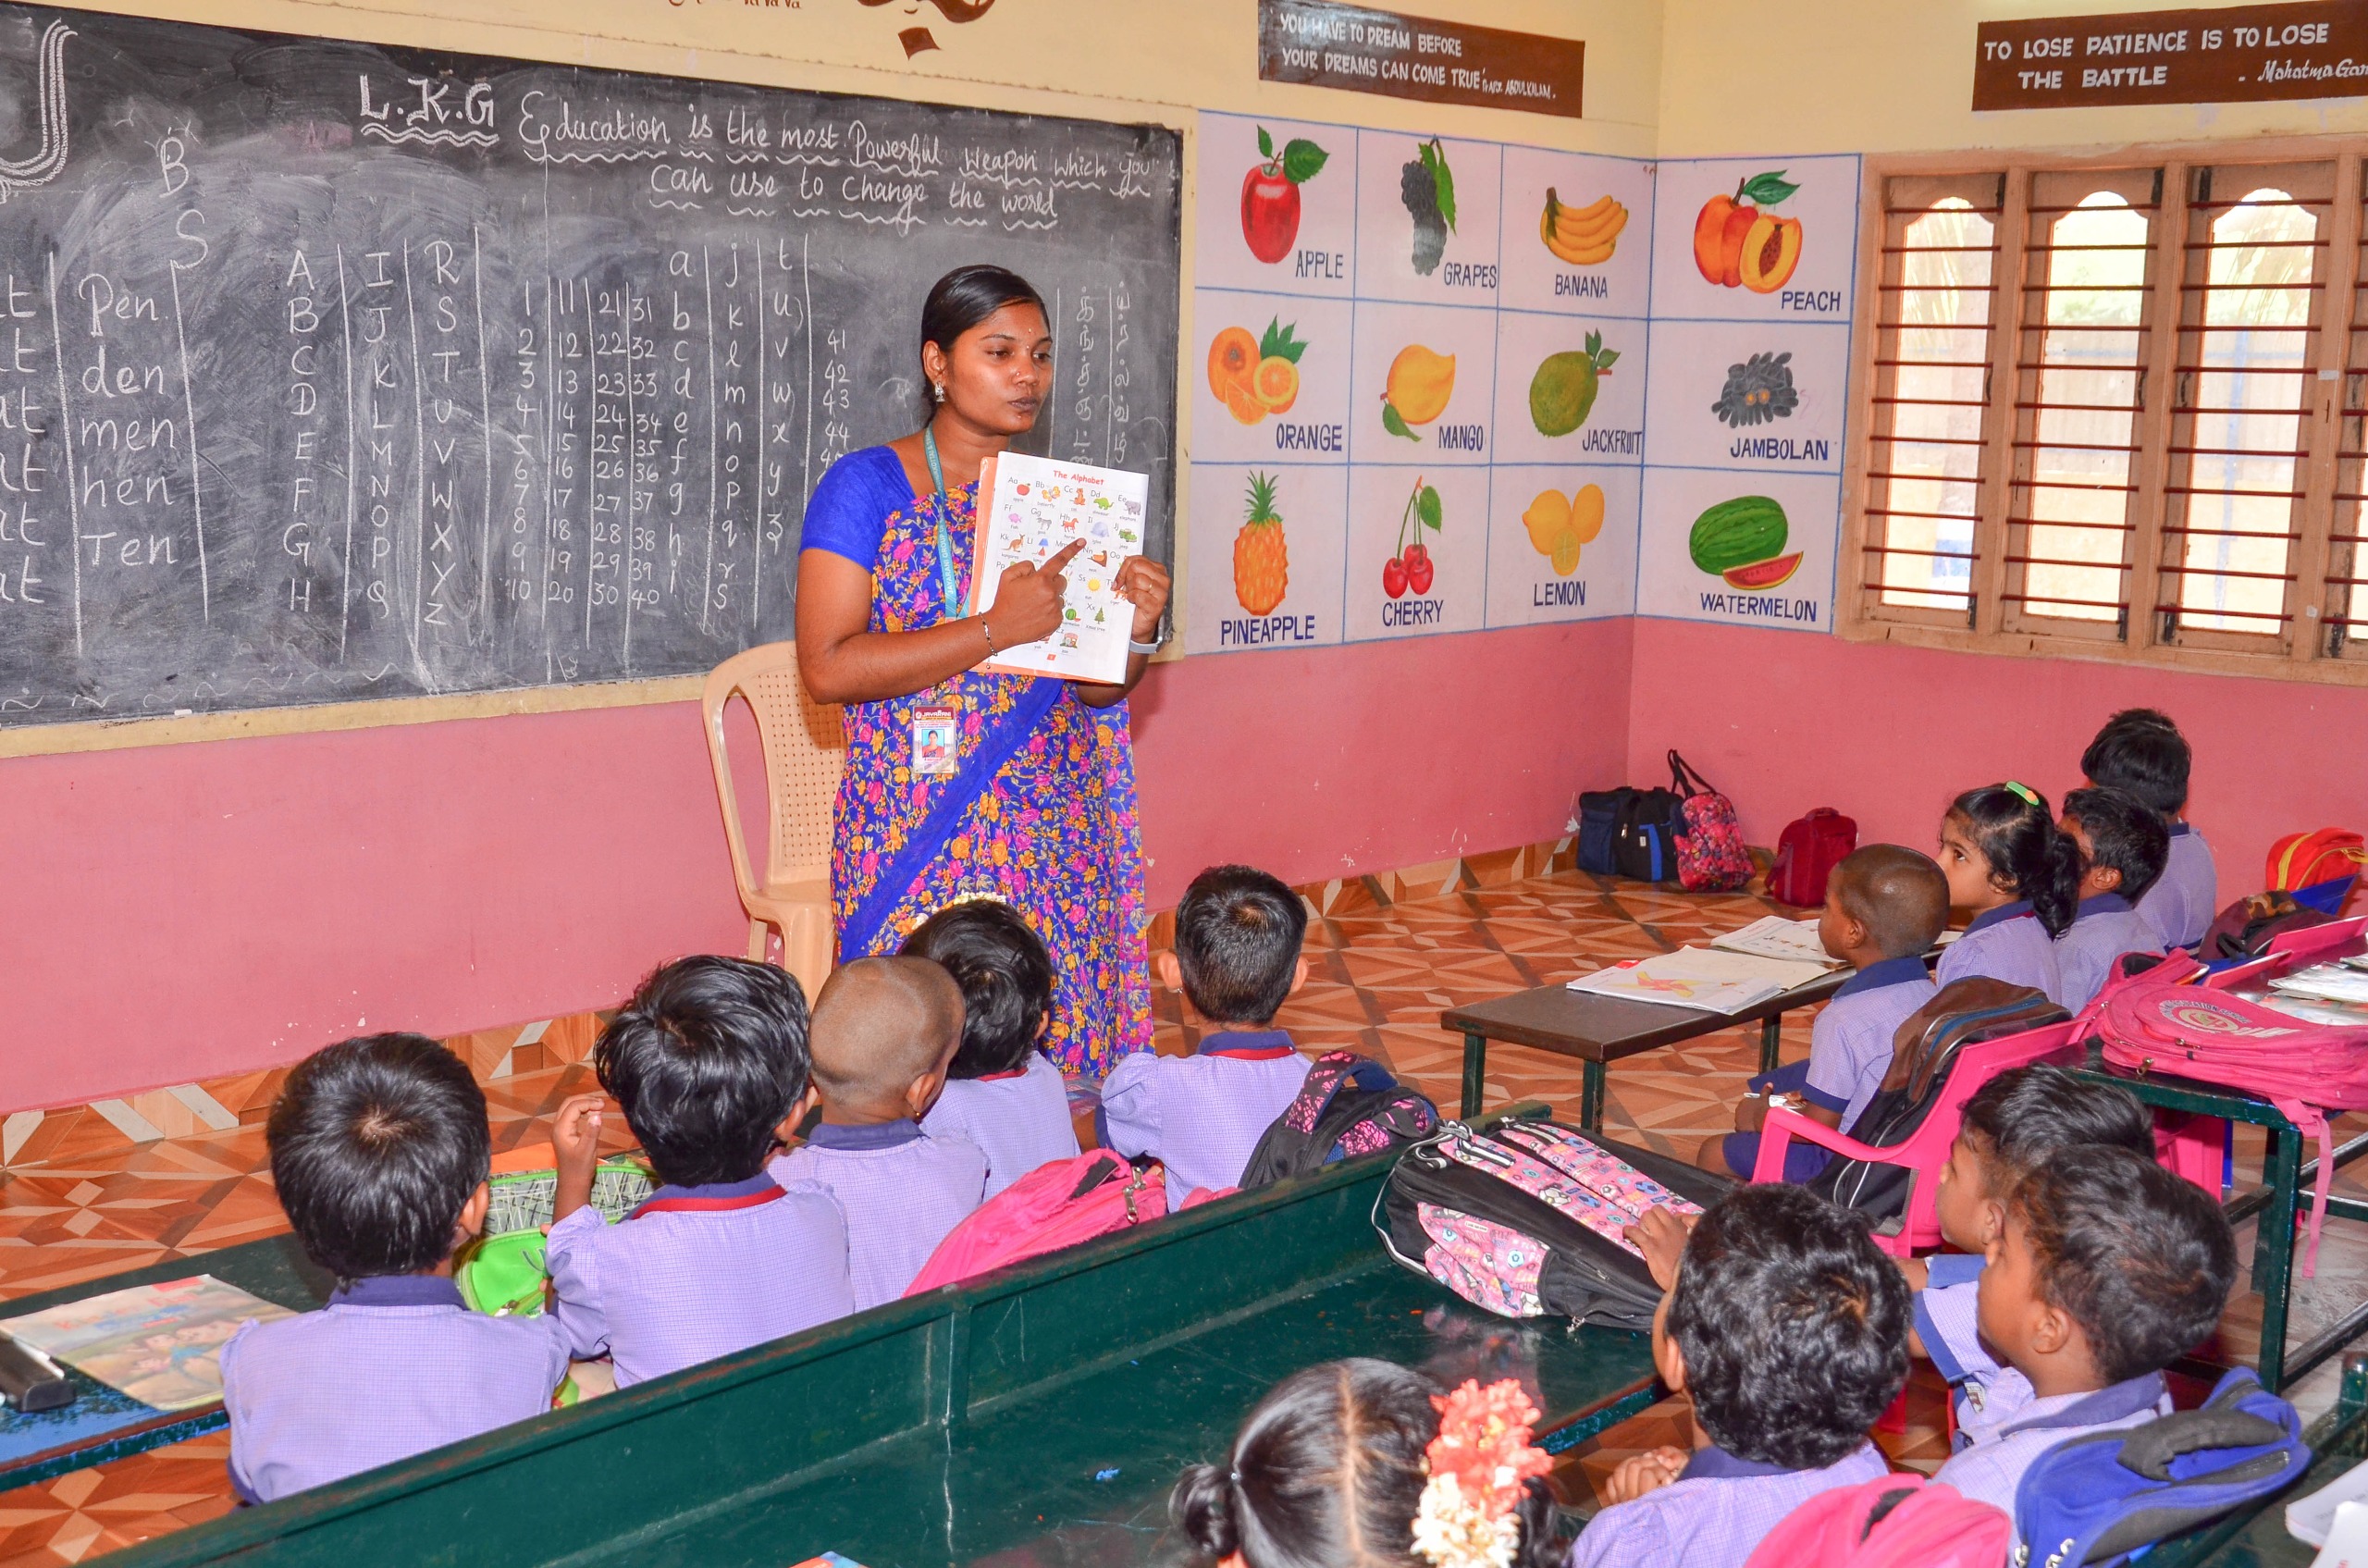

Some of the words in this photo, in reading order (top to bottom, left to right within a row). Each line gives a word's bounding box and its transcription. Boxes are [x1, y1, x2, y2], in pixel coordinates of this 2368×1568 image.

[1312, 18, 1346, 41] HAVE
[1350, 23, 1363, 43] TO
[1368, 26, 1410, 50] DREAM
[1418, 33, 1462, 57] BEFORE
[1985, 41, 2012, 61] TO
[2023, 37, 2074, 60] LOSE
[2086, 30, 2188, 56] PATIENCE
[2202, 29, 2223, 50] IS
[2233, 27, 2260, 48] TO
[2265, 23, 2329, 46] LOSE
[1282, 47, 1318, 70] YOUR
[1325, 52, 1377, 78] DREAMS
[1382, 60, 1408, 80] CAN
[1412, 63, 1446, 85] COME
[2018, 70, 2063, 89] THE
[2082, 66, 2167, 88] BATTLE
[2257, 58, 2332, 83] Mahatma
[688, 104, 713, 140] is
[727, 105, 771, 146] the
[1054, 154, 1107, 178] which
[731, 174, 777, 197] use
[800, 167, 823, 200] to
[950, 181, 985, 208] the
[1003, 187, 1057, 217] world
[425, 241, 460, 284] R
[670, 250, 692, 278] a
[725, 243, 739, 288] j
[780, 239, 793, 270] t
[1296, 250, 1344, 278] APPLE
[287, 250, 314, 290] A
[365, 252, 393, 287] I
[1443, 262, 1498, 289] GRAPES
[1555, 274, 1609, 299] BANANA
[288, 296, 318, 333] B
[436, 296, 457, 332] S
[673, 290, 690, 330] b
[1781, 290, 1842, 313] PEACH
[364, 307, 392, 343] J
[518, 328, 536, 355] 2
[559, 331, 582, 358] 12
[827, 328, 845, 355] 41
[81, 344, 164, 399] den
[291, 346, 314, 375] C
[375, 359, 396, 389] K
[432, 352, 460, 383] T
[519, 361, 535, 389] 3
[824, 359, 851, 391] 42
[597, 375, 626, 395] 23
[632, 372, 658, 396] 33
[674, 367, 695, 401] d
[725, 383, 746, 404] m
[291, 383, 316, 415] D
[435, 399, 452, 423] U
[516, 395, 537, 426] 4
[822, 389, 850, 415] 43
[374, 400, 393, 429] L
[673, 412, 688, 432] e
[80, 417, 177, 451] men
[726, 419, 742, 443] n
[824, 420, 850, 449] 44
[1276, 423, 1343, 451] ORANGE
[1439, 425, 1484, 451] MANGO
[1583, 429, 1643, 455] JACKFRUIT
[295, 432, 315, 460] E
[372, 441, 392, 465] M
[434, 438, 455, 464] V
[671, 438, 688, 475] f
[1730, 438, 1828, 461] JAMBOLAN
[514, 459, 527, 482] 6
[556, 454, 573, 478] 16
[767, 462, 783, 497] y
[1054, 470, 1067, 479] The
[1071, 474, 1104, 485] Alphabet
[83, 465, 176, 508] hen
[293, 477, 314, 512] F
[372, 475, 389, 498] N
[432, 481, 452, 510] W
[515, 484, 528, 505] 7
[670, 482, 684, 515] g
[371, 505, 389, 526] O
[514, 507, 526, 533] 8
[283, 523, 308, 566] G
[430, 522, 451, 553] X
[594, 523, 622, 542] 28
[669, 523, 683, 556] h
[940, 532, 950, 559] GROUP
[373, 537, 391, 569] P
[431, 561, 456, 597] Y
[549, 581, 574, 602] 20
[943, 560, 955, 594] JAYARANI
[290, 578, 311, 611] H
[367, 581, 389, 619] Q
[632, 584, 660, 611] 40
[1534, 581, 1586, 607] LEMON
[1700, 592, 1817, 623] WATERMELON
[424, 602, 448, 625] Z
[1382, 599, 1444, 627] CHERRY
[1221, 614, 1315, 646] PINEAPPLE
